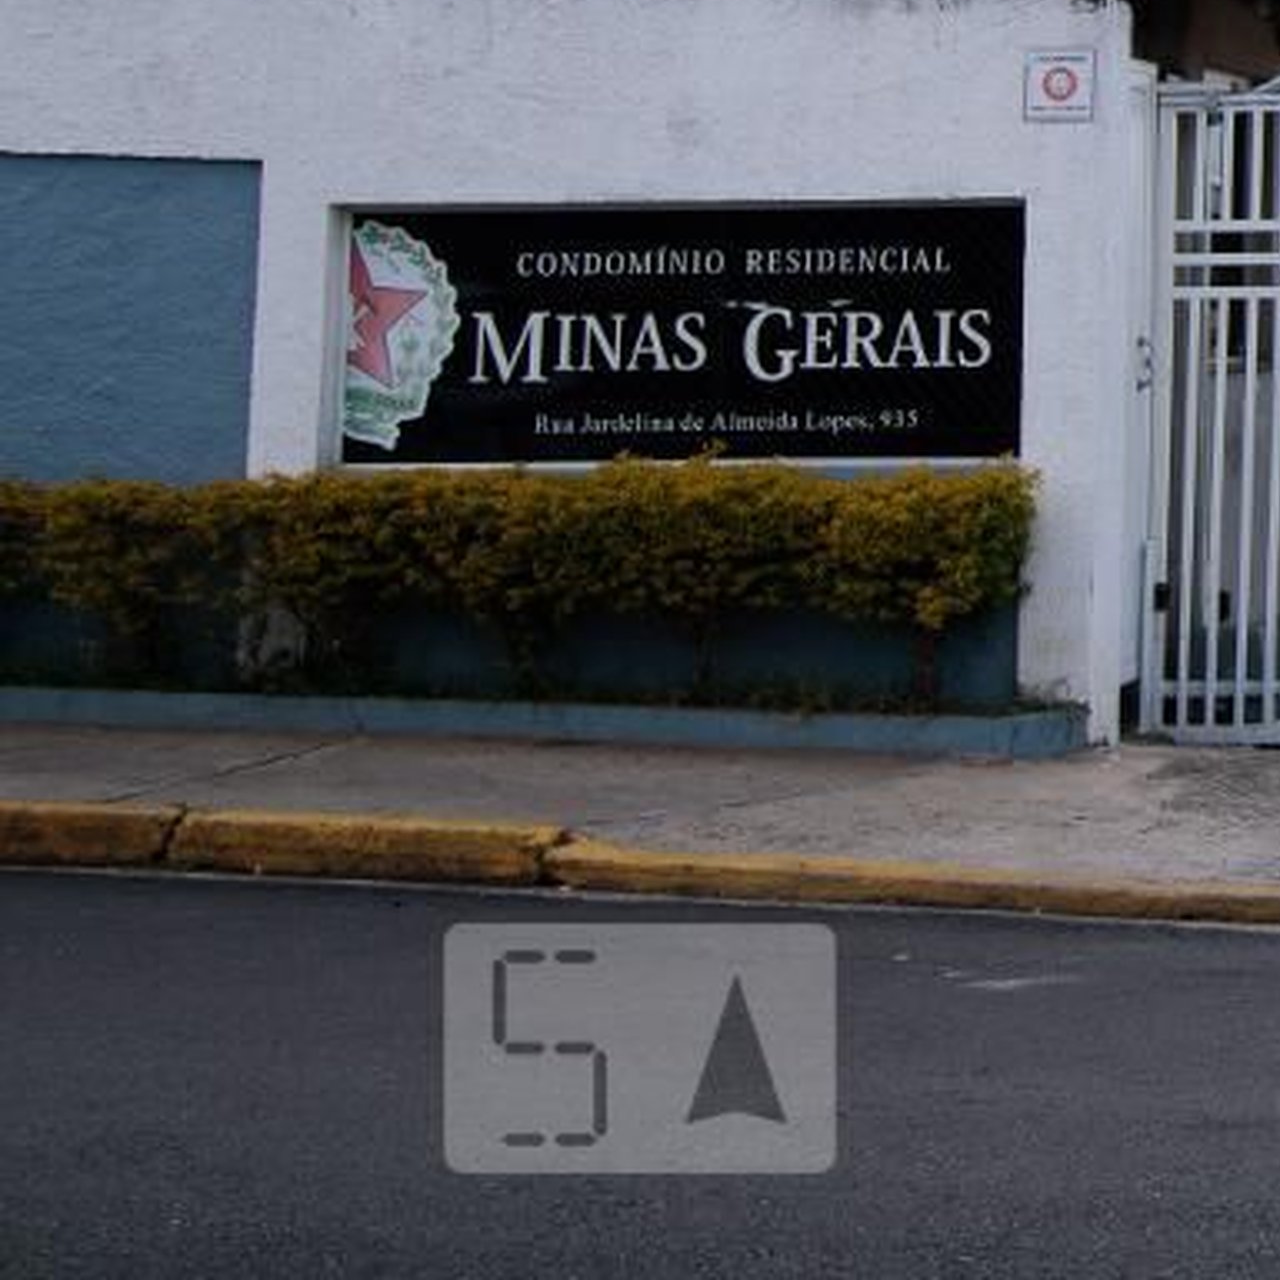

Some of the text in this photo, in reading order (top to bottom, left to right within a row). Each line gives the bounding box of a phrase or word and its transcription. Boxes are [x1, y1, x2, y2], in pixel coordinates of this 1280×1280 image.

[516, 245, 952, 277] CONDOMÍNIO RESIDENCIAL
[467, 310, 708, 386] MINAS
[533, 413, 575, 435] Rua
[678, 412, 704, 433] de
[709, 410, 800, 432] Almeida
[878, 408, 919, 429] 935
